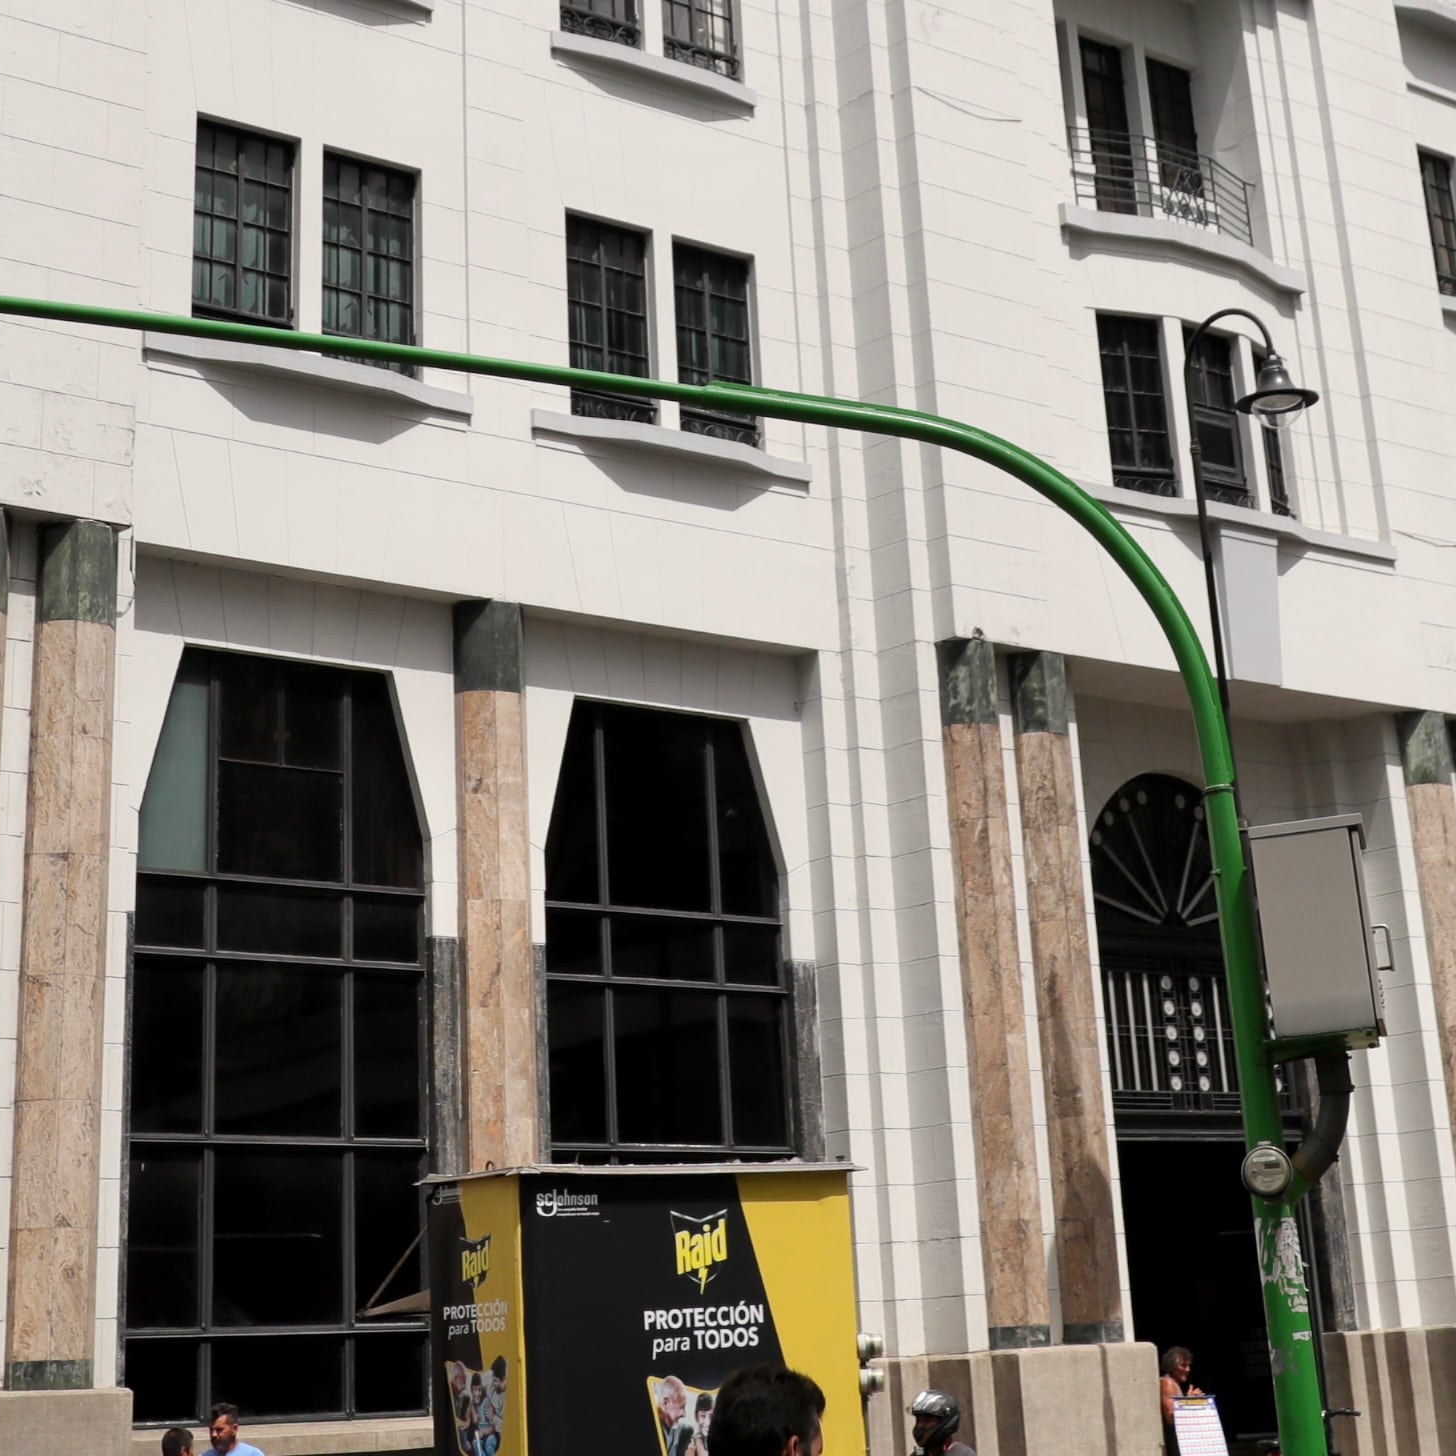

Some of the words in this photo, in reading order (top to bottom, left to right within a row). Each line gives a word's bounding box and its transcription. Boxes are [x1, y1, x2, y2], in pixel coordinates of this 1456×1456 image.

[461, 1240, 489, 1282] Raid
[675, 1218, 727, 1275] Raid
[443, 1298, 508, 1320] PROTECCIÓN
[643, 1300, 764, 1331] PROTECCIÓN
[448, 1324, 469, 1341] para
[470, 1316, 506, 1333] TODOS
[652, 1336, 690, 1360] para
[693, 1326, 759, 1350] TODOS
